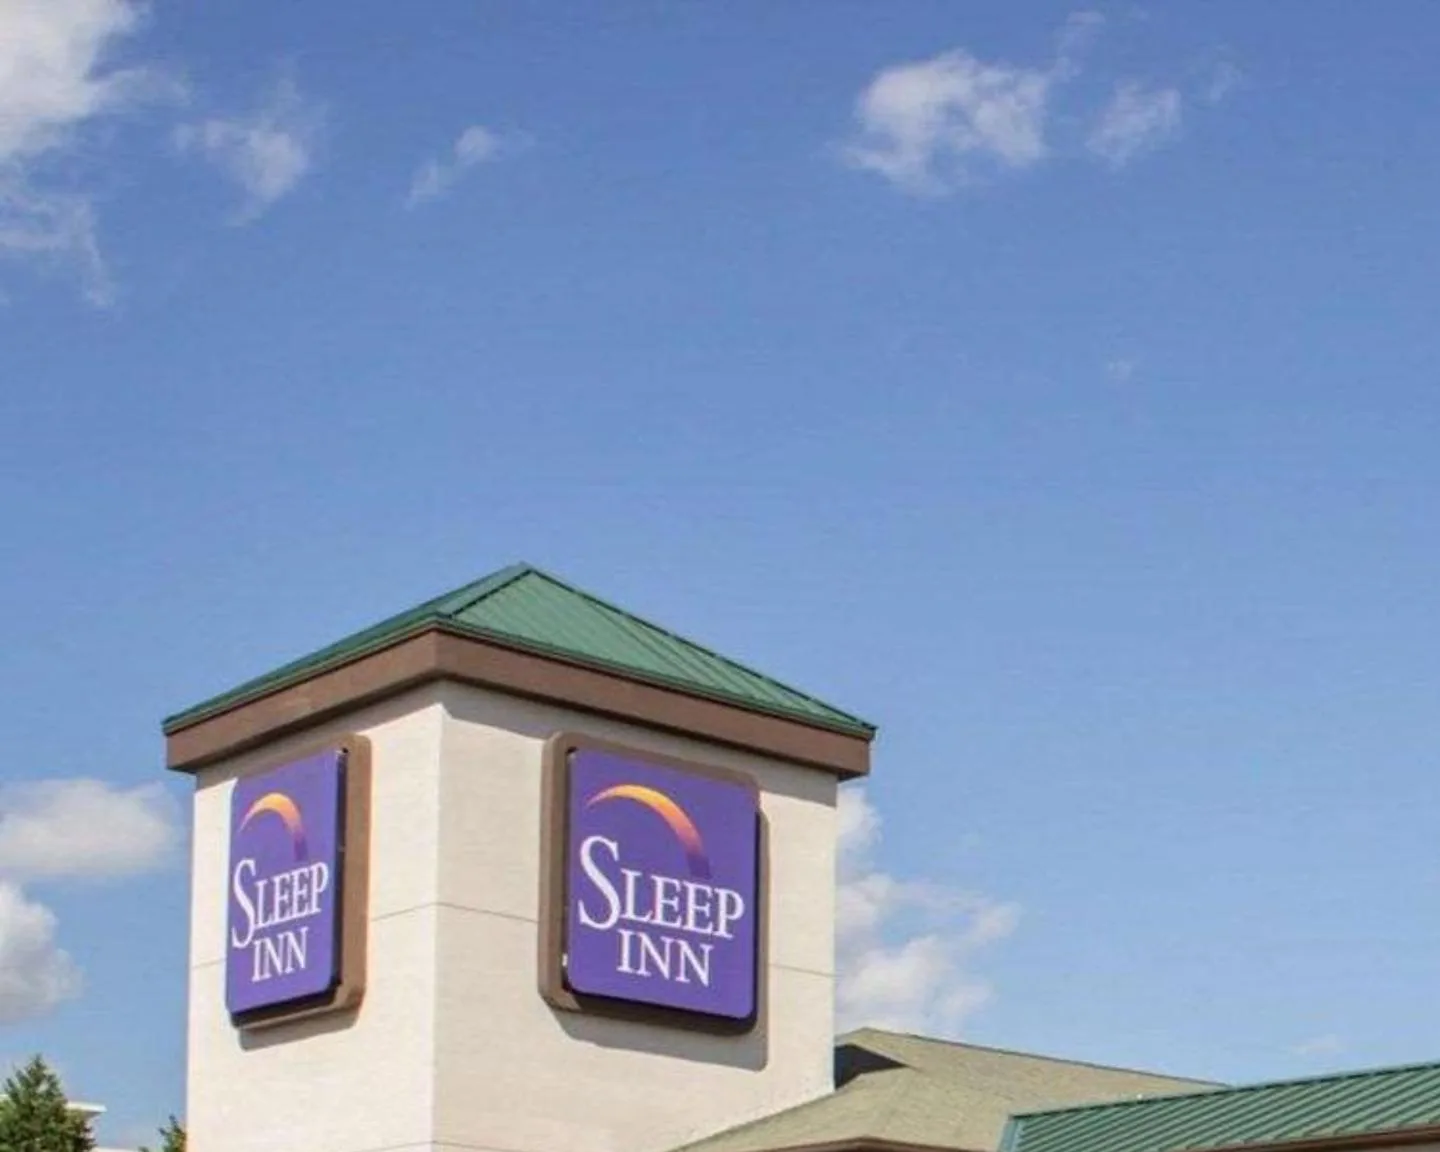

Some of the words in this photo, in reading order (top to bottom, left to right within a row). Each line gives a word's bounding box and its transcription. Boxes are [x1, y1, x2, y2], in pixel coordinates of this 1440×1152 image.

[232, 858, 328, 948] SLEEP
[578, 835, 744, 938] SLEEP
[252, 926, 308, 982] INN
[617, 929, 713, 986] INN
